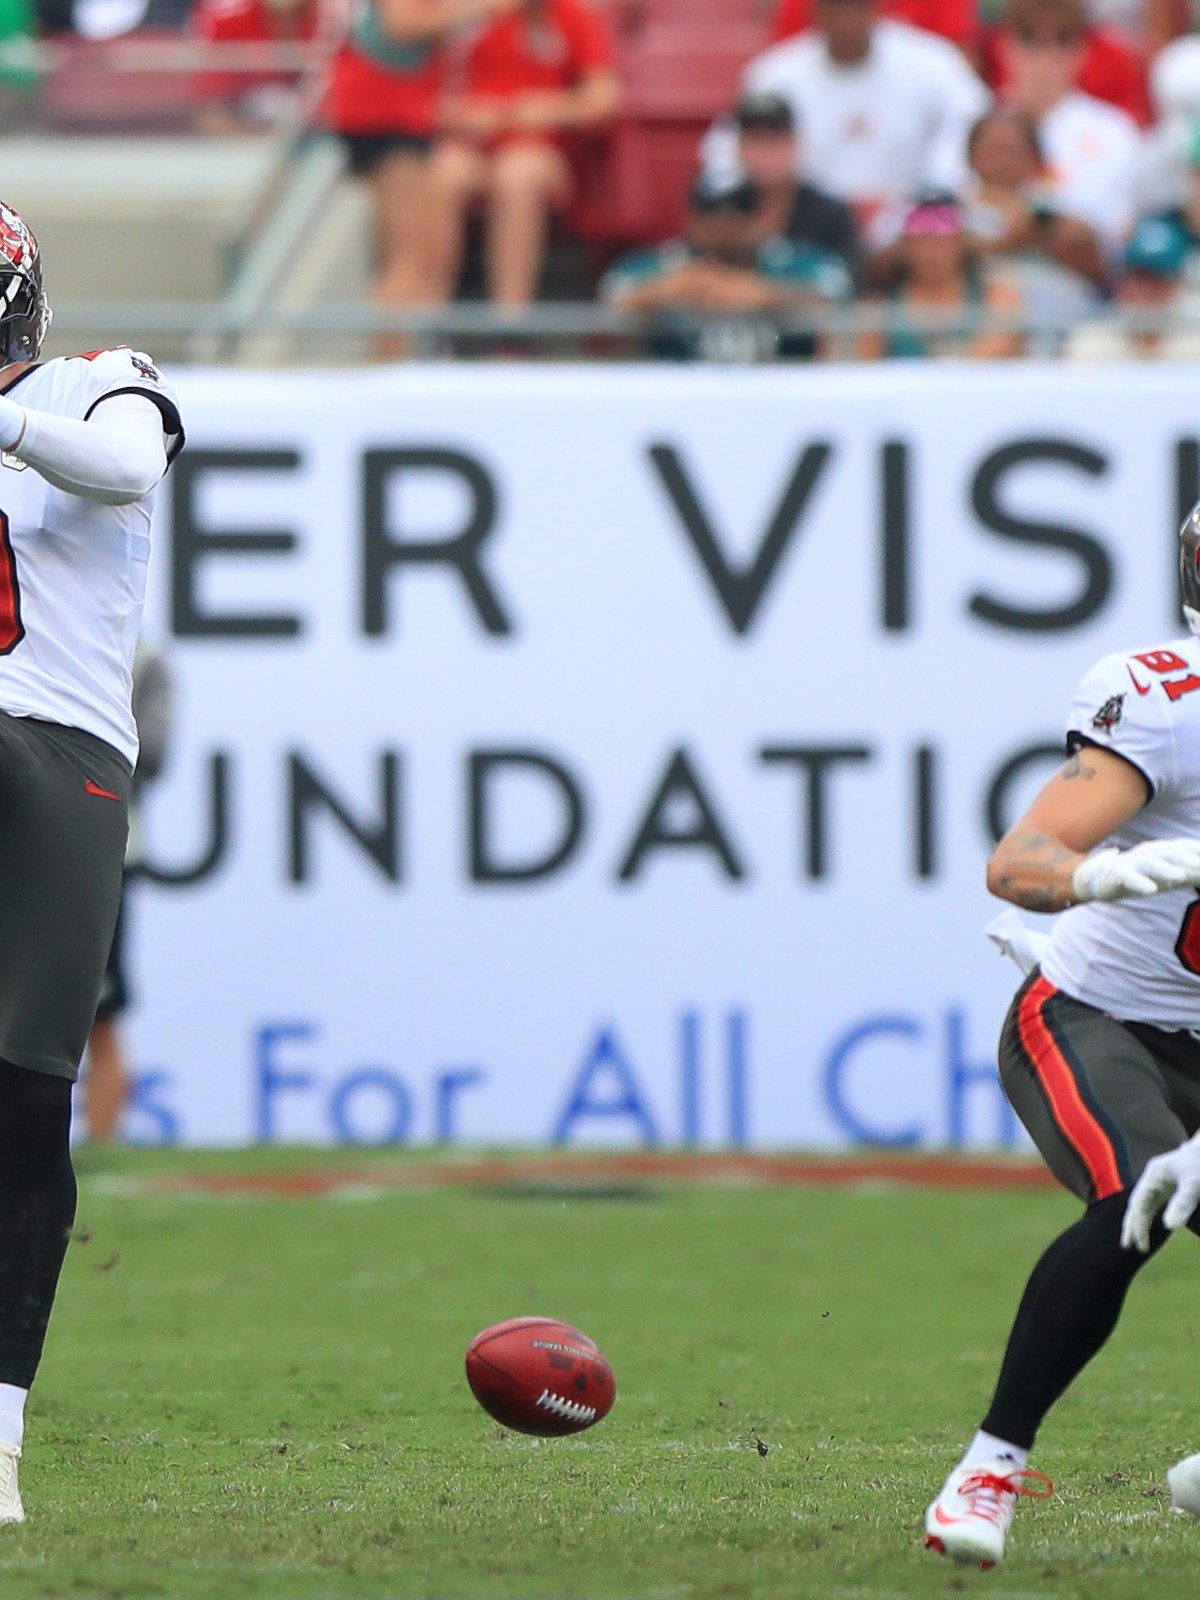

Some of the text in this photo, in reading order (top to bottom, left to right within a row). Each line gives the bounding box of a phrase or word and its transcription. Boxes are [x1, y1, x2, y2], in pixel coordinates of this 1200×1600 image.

[170, 445, 512, 639] ER
[128, 743, 1072, 889] UNDATI
[252, 1021, 481, 1145] For
[548, 1009, 750, 1145] All
